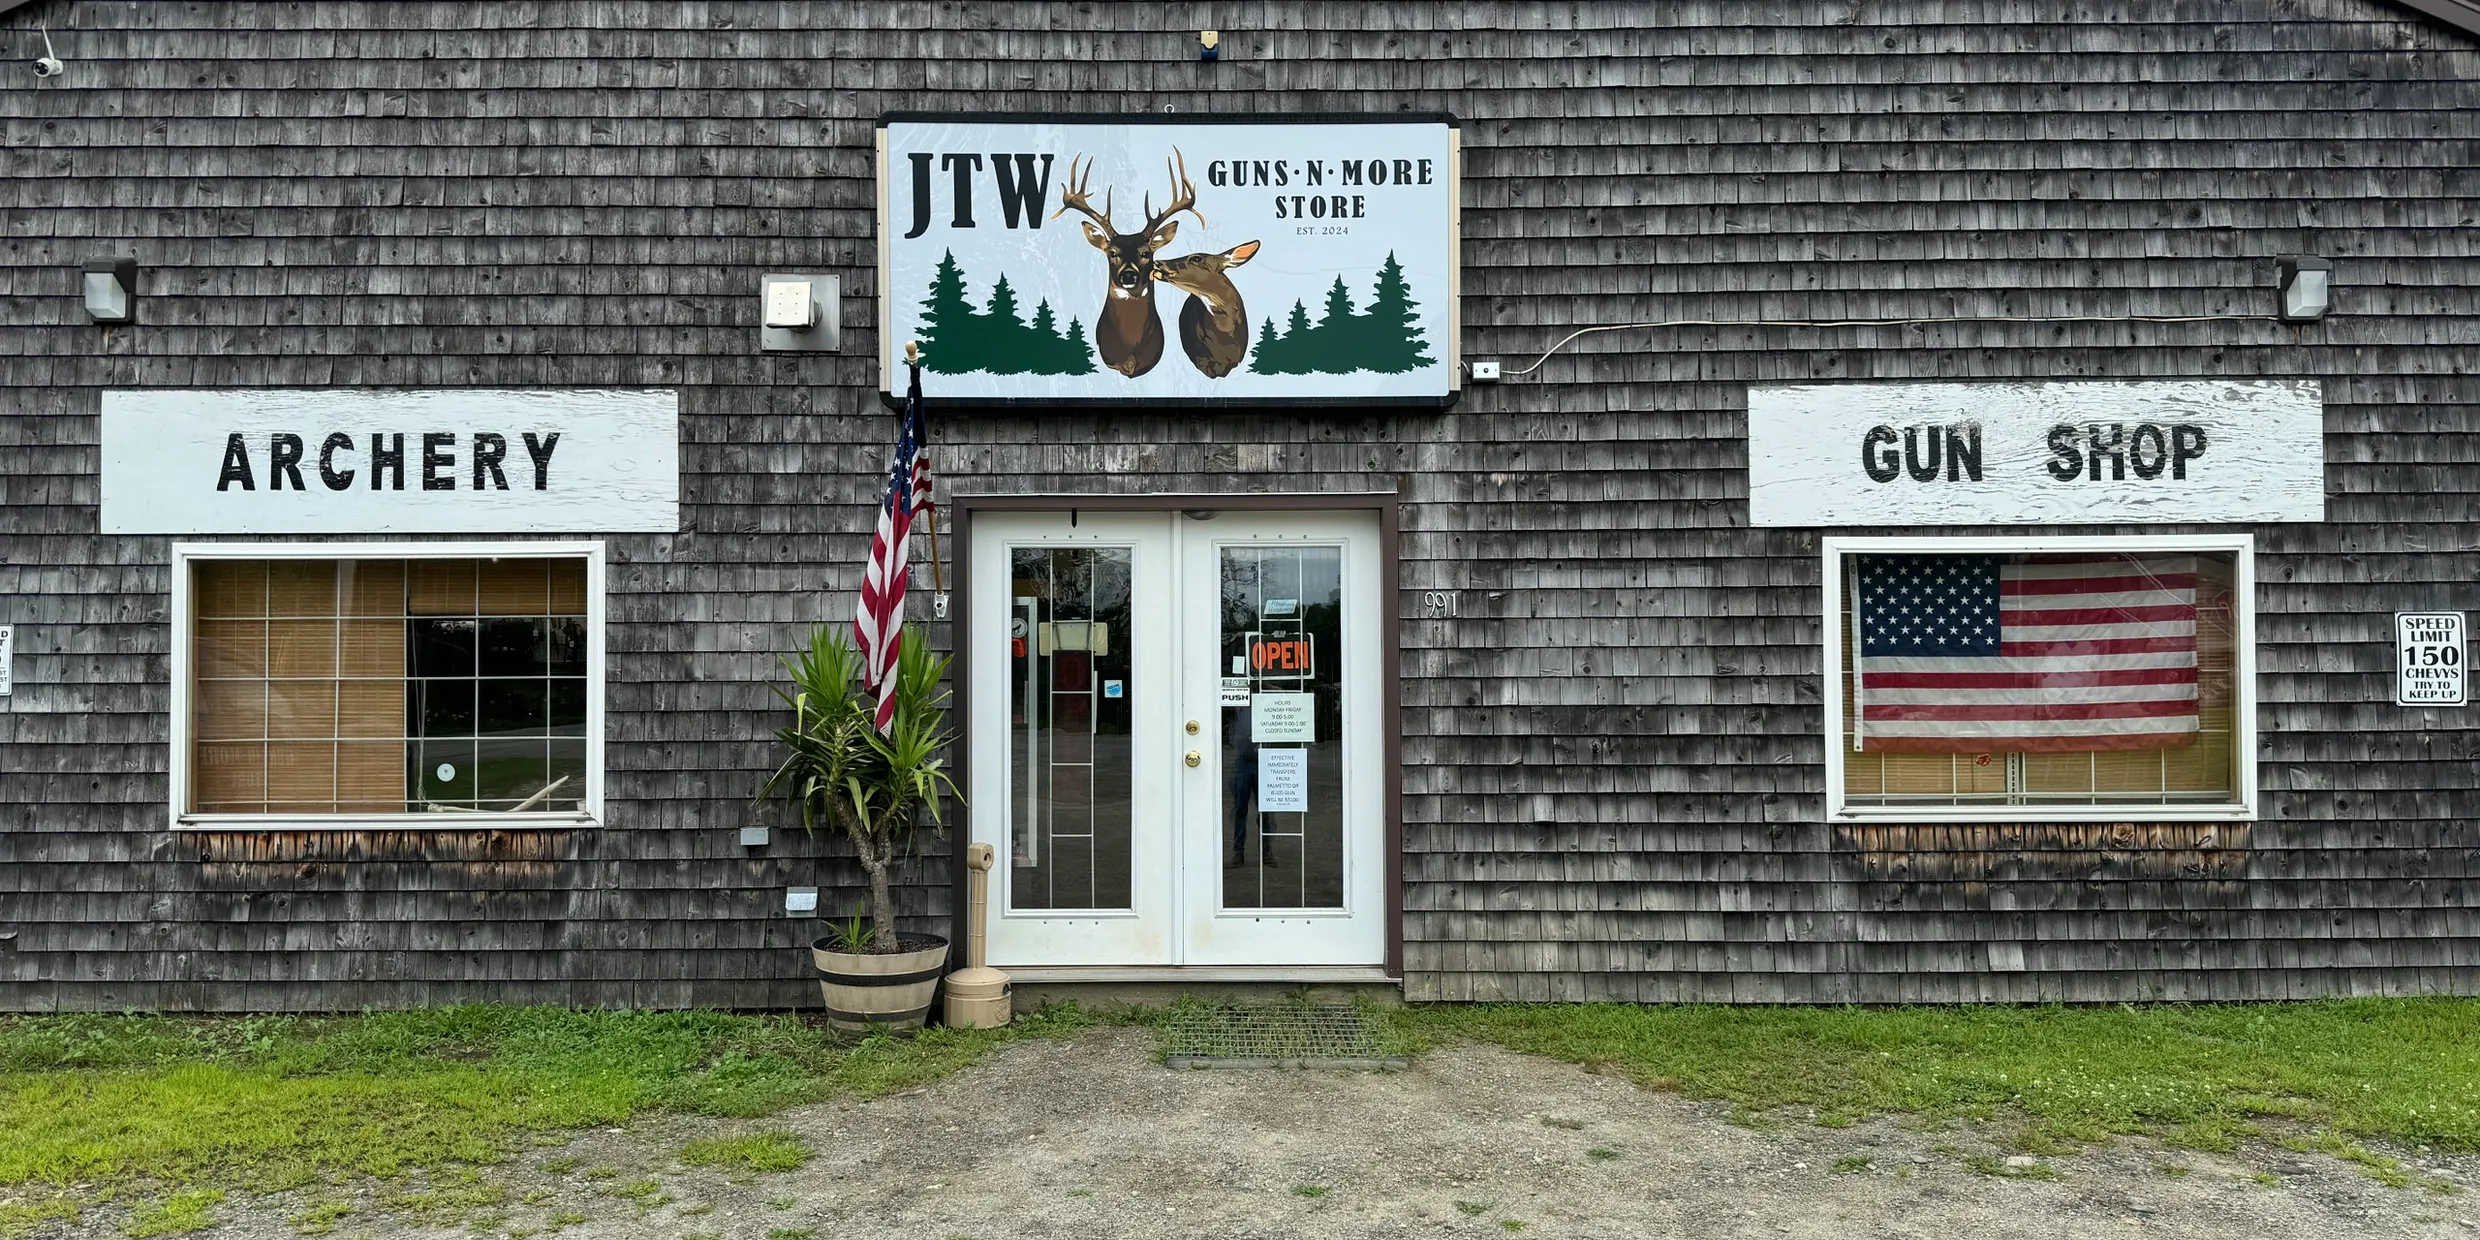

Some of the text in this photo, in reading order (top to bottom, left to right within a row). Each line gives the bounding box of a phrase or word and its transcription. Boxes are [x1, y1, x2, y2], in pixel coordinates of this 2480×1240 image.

[904, 152, 1055, 239] JTW
[1275, 195, 1366, 219] STORE
[1296, 226, 1349, 236] EST. 2024
[216, 431, 561, 492] ARCHERY
[1862, 423, 2208, 483] GUN SHOP
[1424, 591, 1457, 617] 991
[2405, 617, 2456, 630] SPEED
[2410, 630, 2453, 642] LIMIT
[1252, 641, 1309, 670] OPEN
[2404, 645, 2459, 666] 150
[2405, 668, 2459, 679] CHEVYS
[2409, 690, 2457, 699] KEEP UP
[2414, 681, 2451, 690] TRY TO
